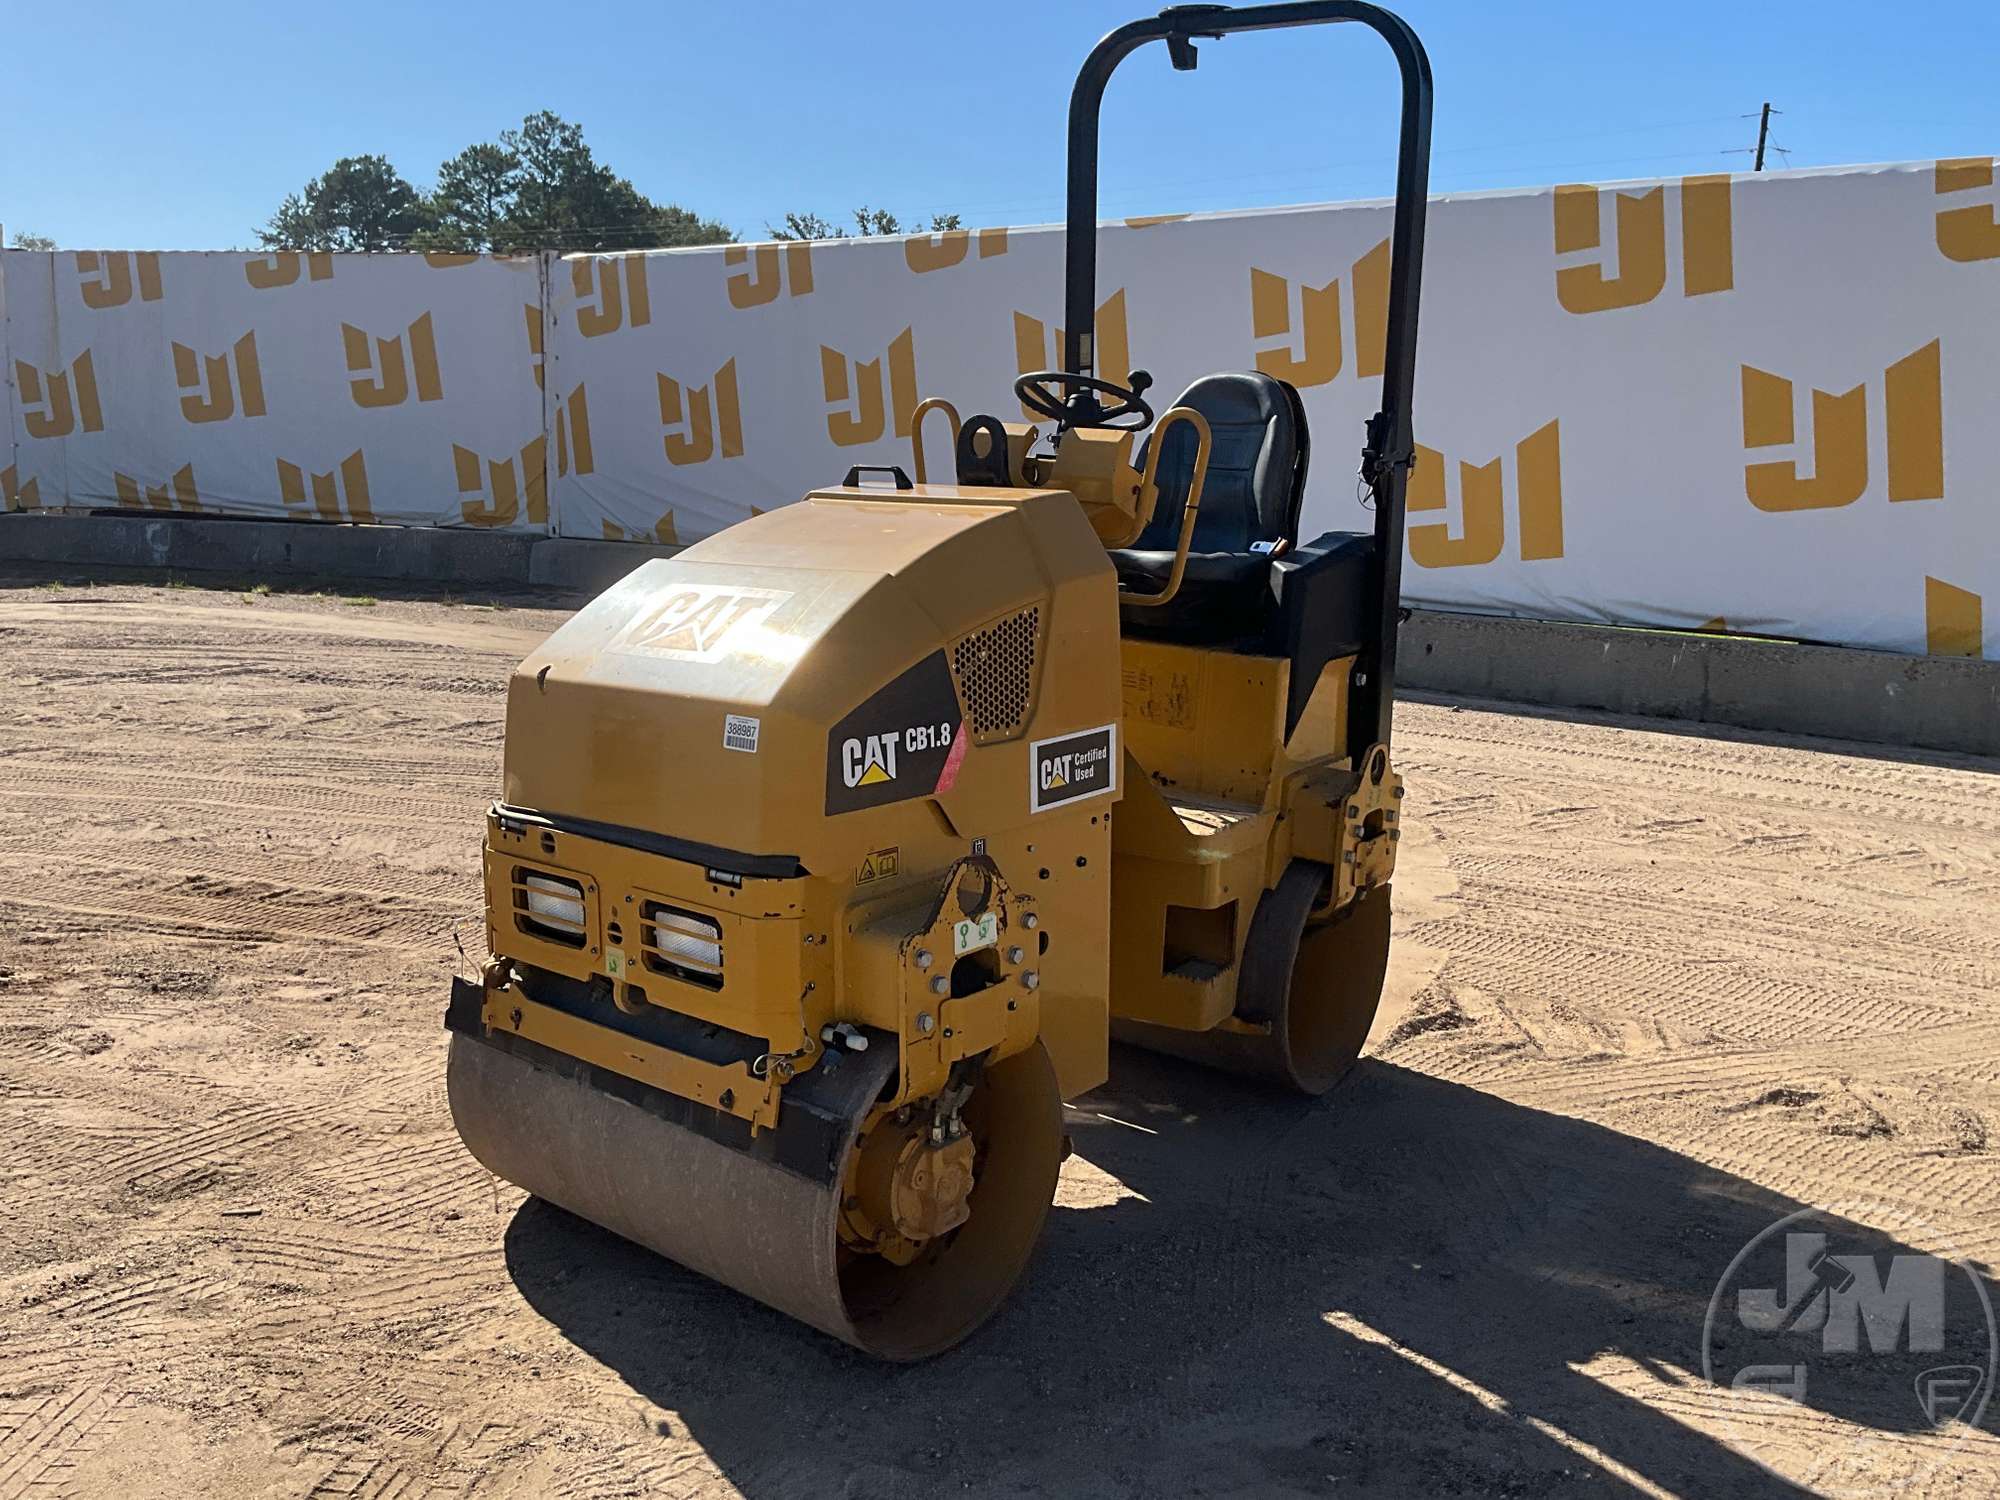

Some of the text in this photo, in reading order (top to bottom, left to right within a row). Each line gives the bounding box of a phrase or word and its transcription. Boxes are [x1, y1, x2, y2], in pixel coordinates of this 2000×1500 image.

[625, 591, 773, 652] CAT
[727, 721, 757, 738] 388987
[842, 722, 951, 788] CAT CB1.8
[1074, 747, 1107, 766] Certified
[1040, 753, 1071, 791] CAT
[1074, 767, 1095, 782] Used
